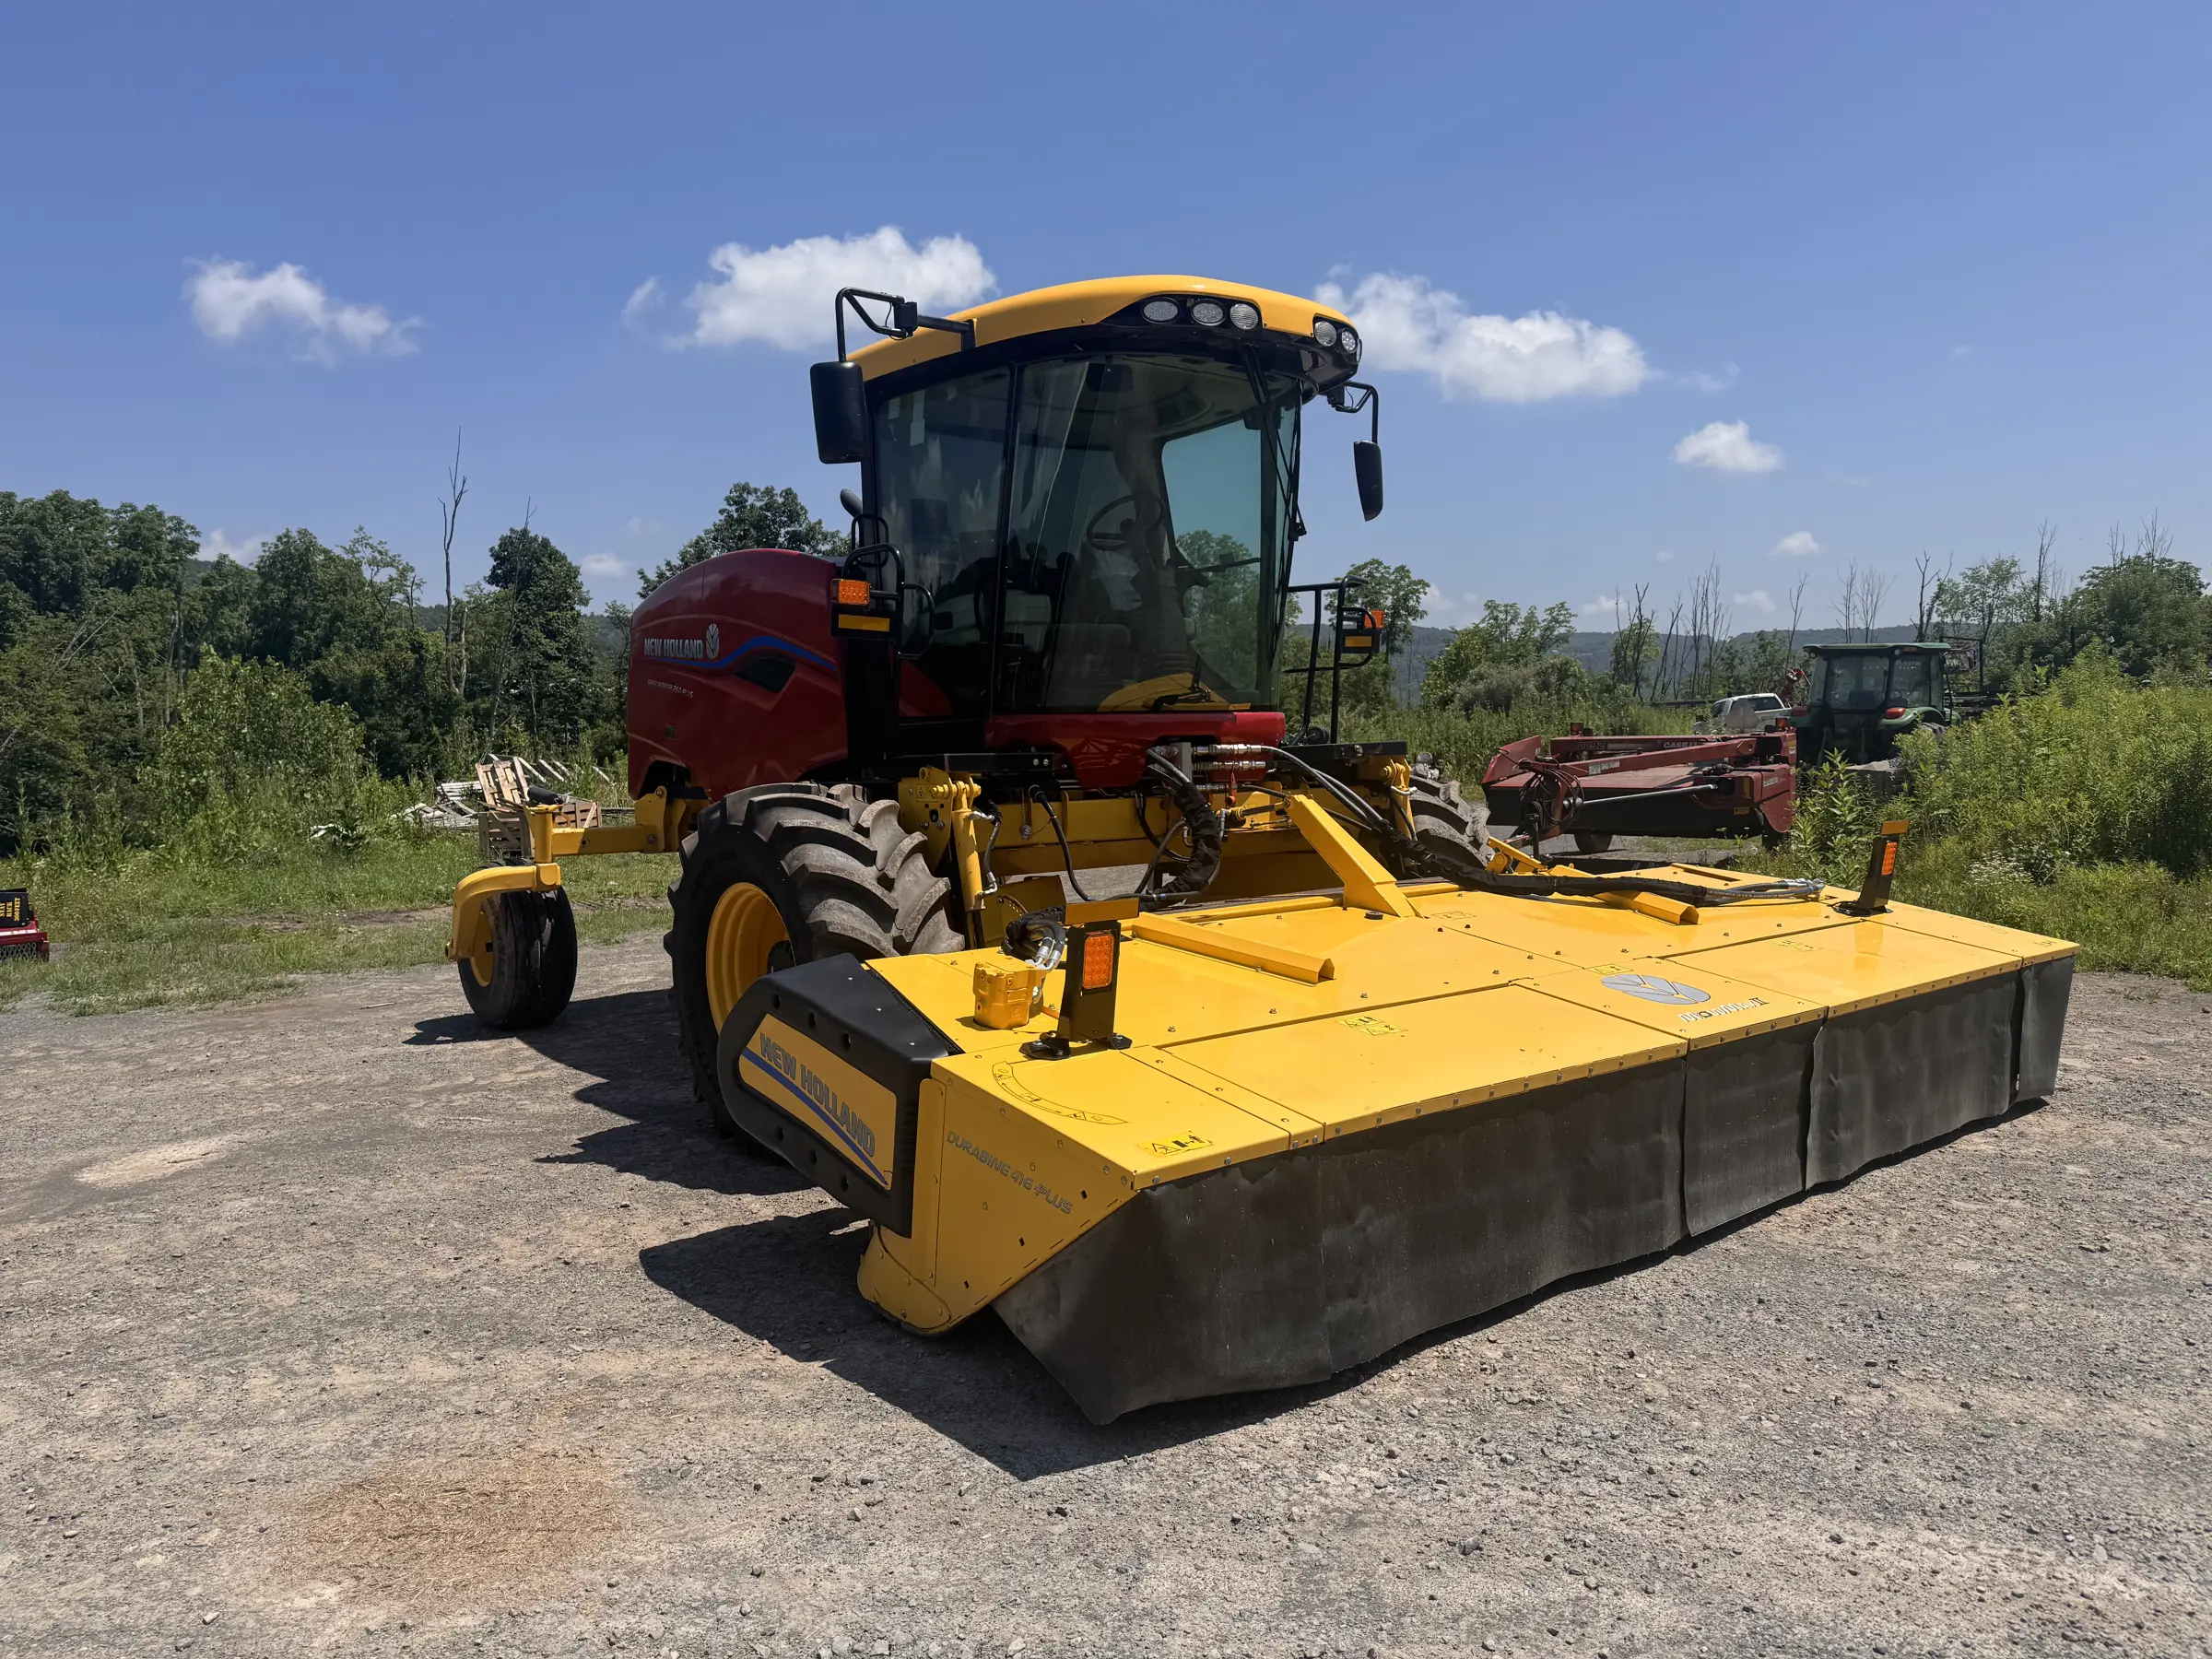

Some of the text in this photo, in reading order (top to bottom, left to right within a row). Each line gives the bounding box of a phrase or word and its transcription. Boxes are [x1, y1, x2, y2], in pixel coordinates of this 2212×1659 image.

[644, 638, 703, 659] NEW HOLLAND
[759, 1031, 797, 1081] NEW
[800, 1063, 876, 1158] HOLLAND
[947, 1129, 1073, 1215] DURABINE 416 PLUS
